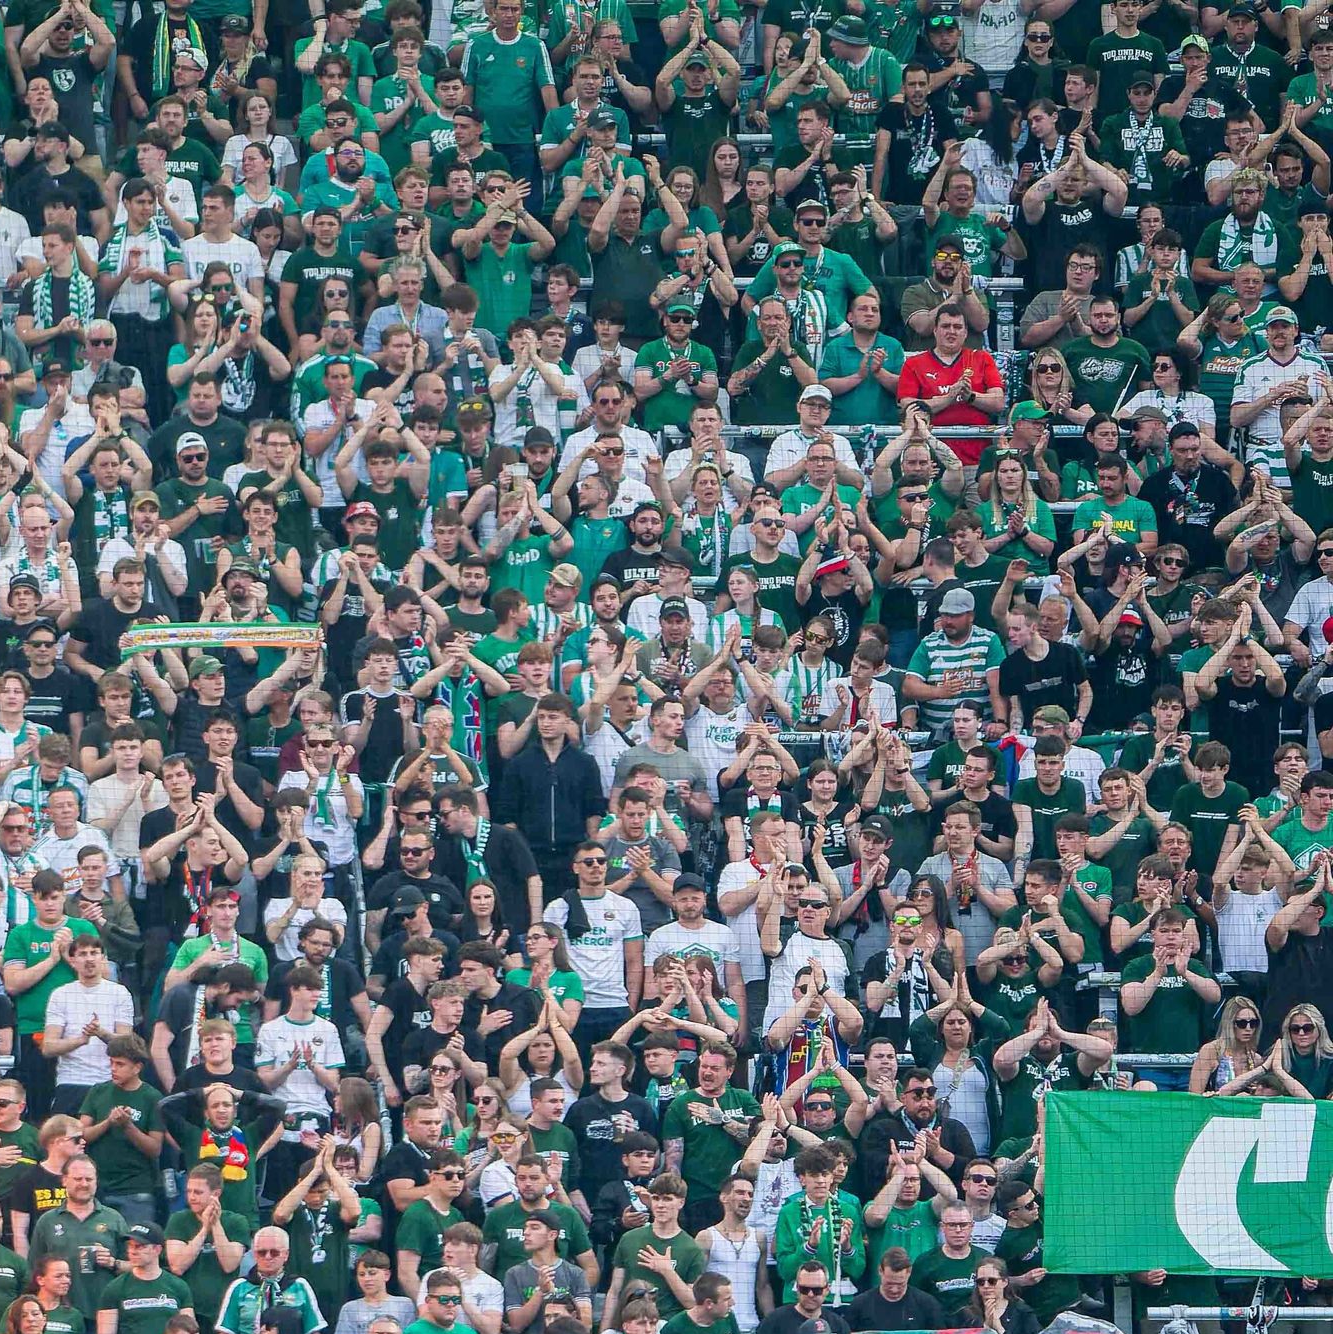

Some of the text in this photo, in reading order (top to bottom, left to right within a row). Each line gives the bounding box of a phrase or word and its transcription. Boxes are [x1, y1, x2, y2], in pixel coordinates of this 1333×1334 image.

[980, 11, 1017, 27] RAPID
[1101, 48, 1154, 62] TOD UND HASS
[775, 576, 795, 587] HASS
